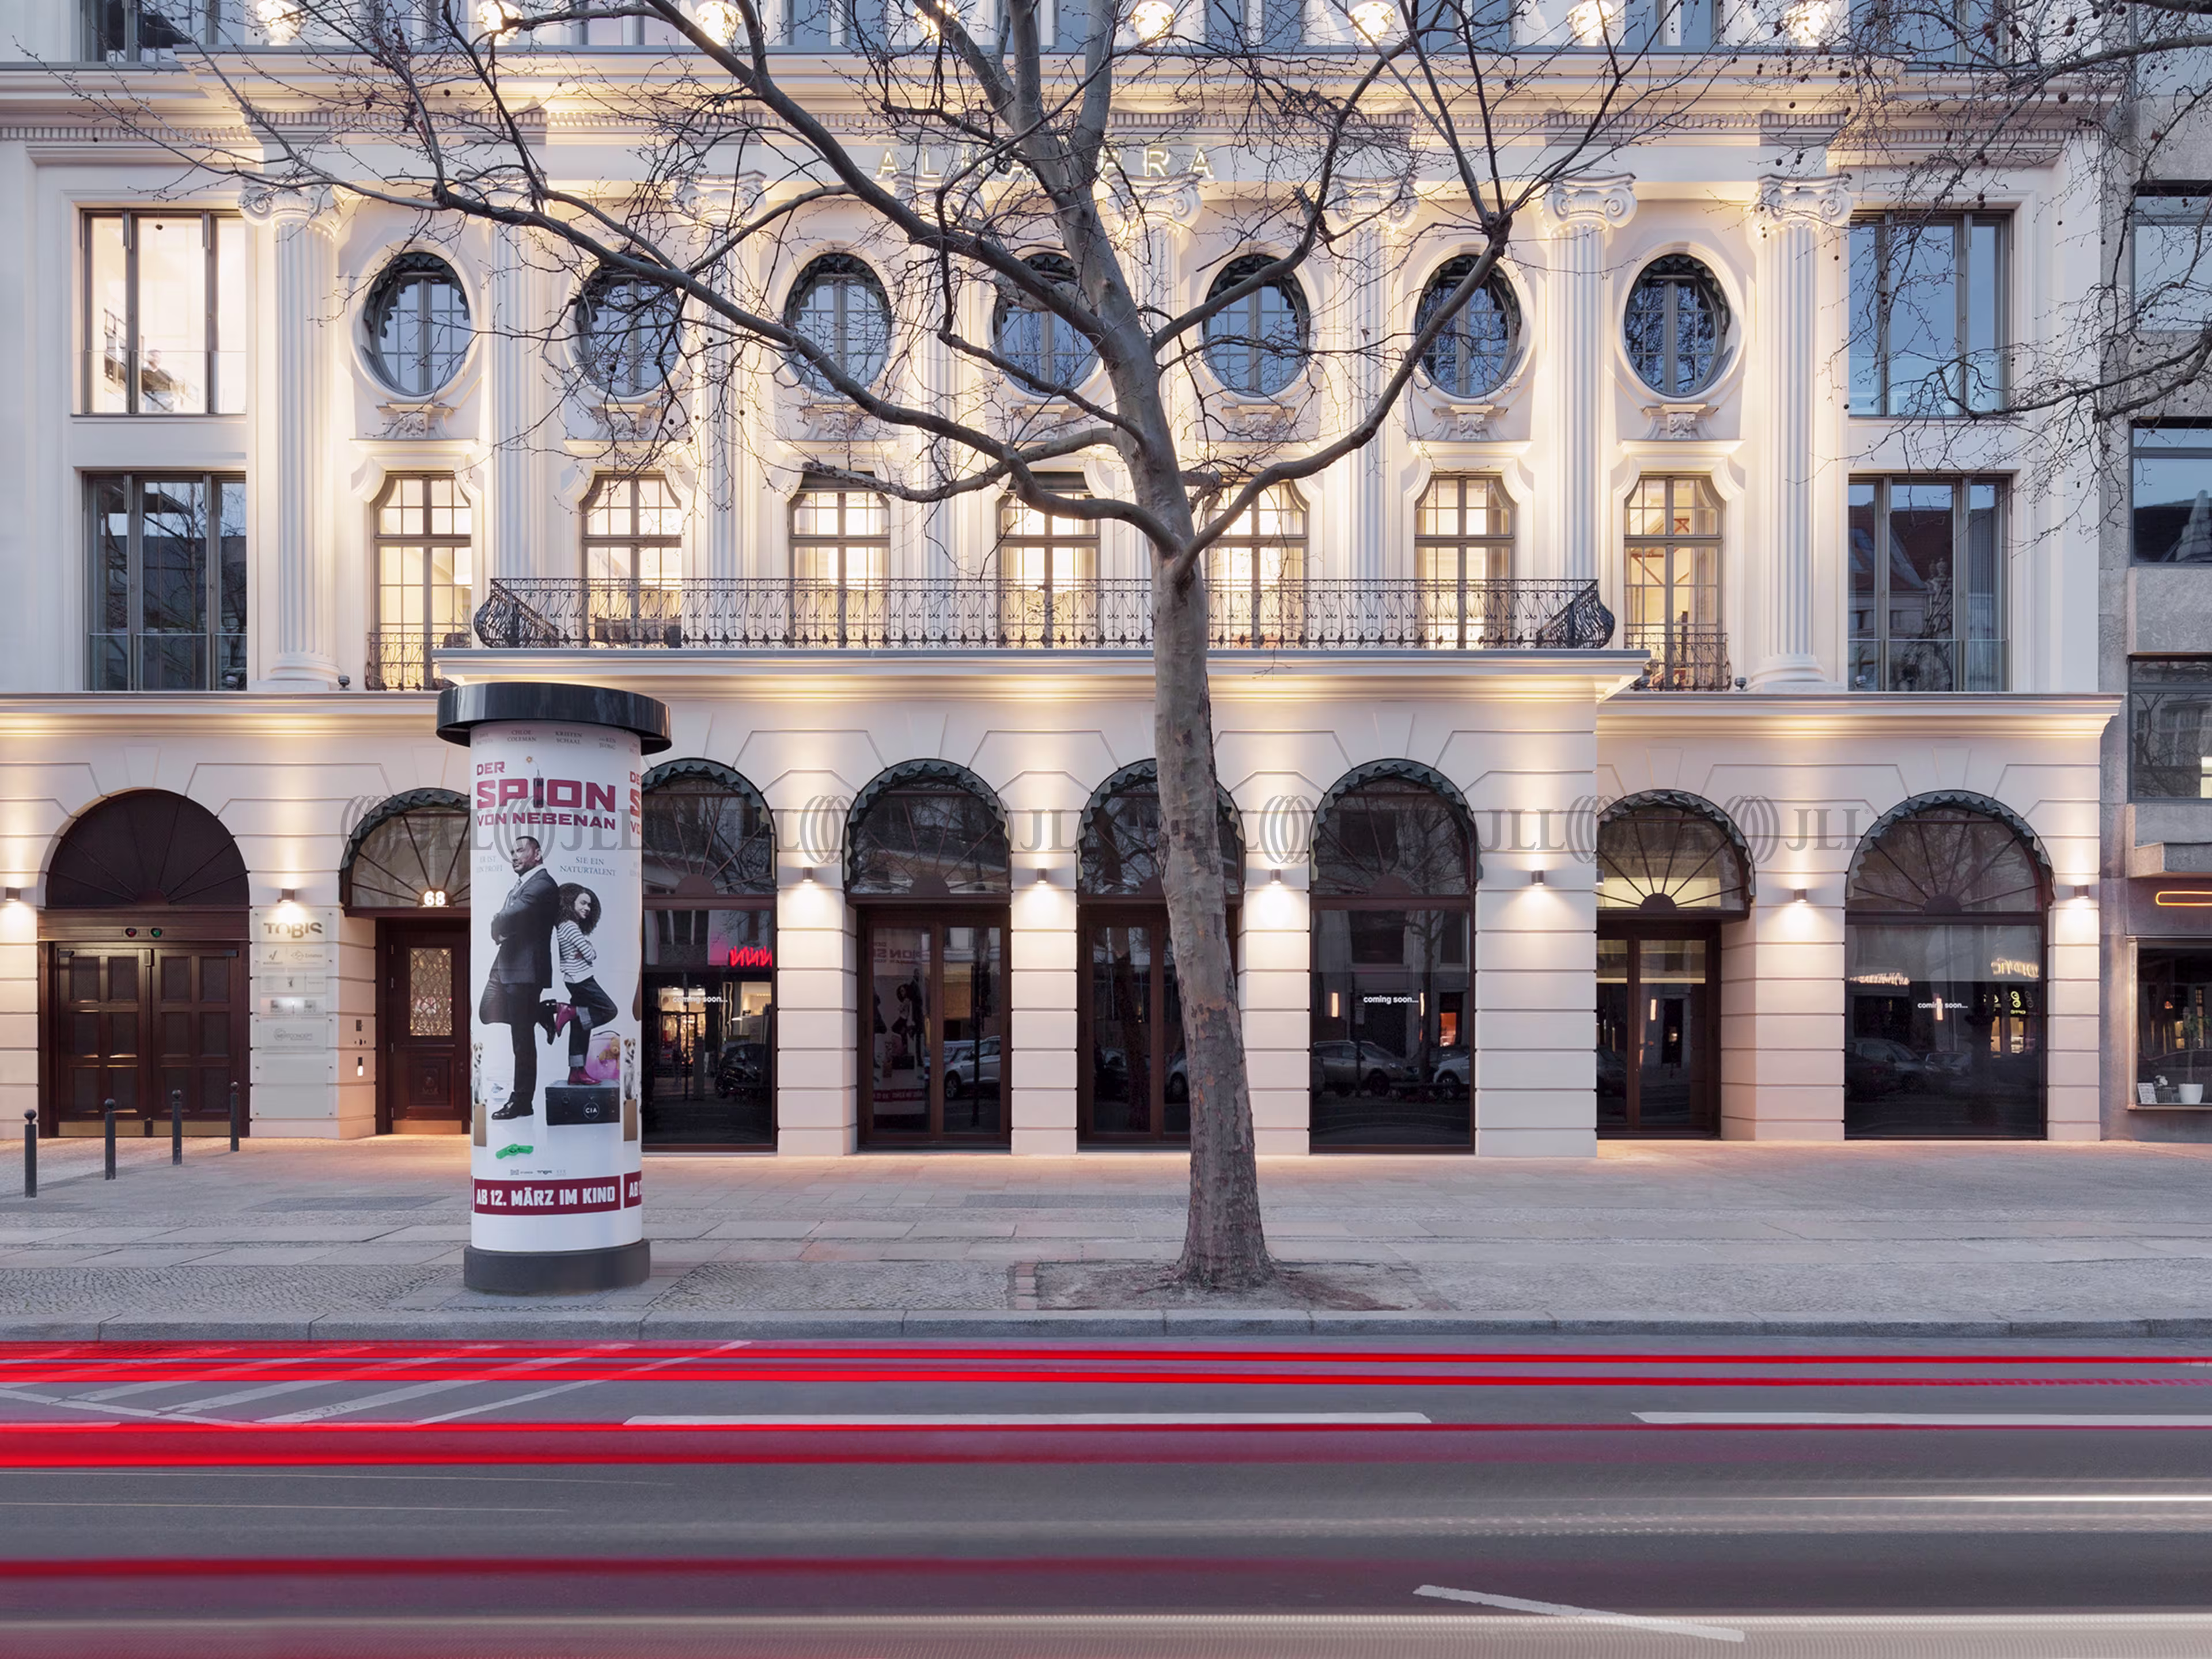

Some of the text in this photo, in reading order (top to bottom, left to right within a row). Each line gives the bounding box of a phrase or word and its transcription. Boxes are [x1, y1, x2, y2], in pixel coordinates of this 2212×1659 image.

[875, 146, 1214, 179] ALHABRA
[476, 761, 505, 776] DER
[630, 770, 640, 786] DE
[476, 778, 616, 813] SPION
[477, 813, 507, 827] VON
[512, 812, 616, 830] NEBENAN
[576, 857, 604, 865] SIE EIN
[560, 865, 616, 877] NATURTALENT
[425, 891, 446, 906] 68
[263, 922, 323, 938] TOBIS
[673, 995, 701, 1004] coming
[1363, 995, 1392, 1005] coming
[476, 1186, 615, 1206] AB 12. MÄRZ IM KINO
